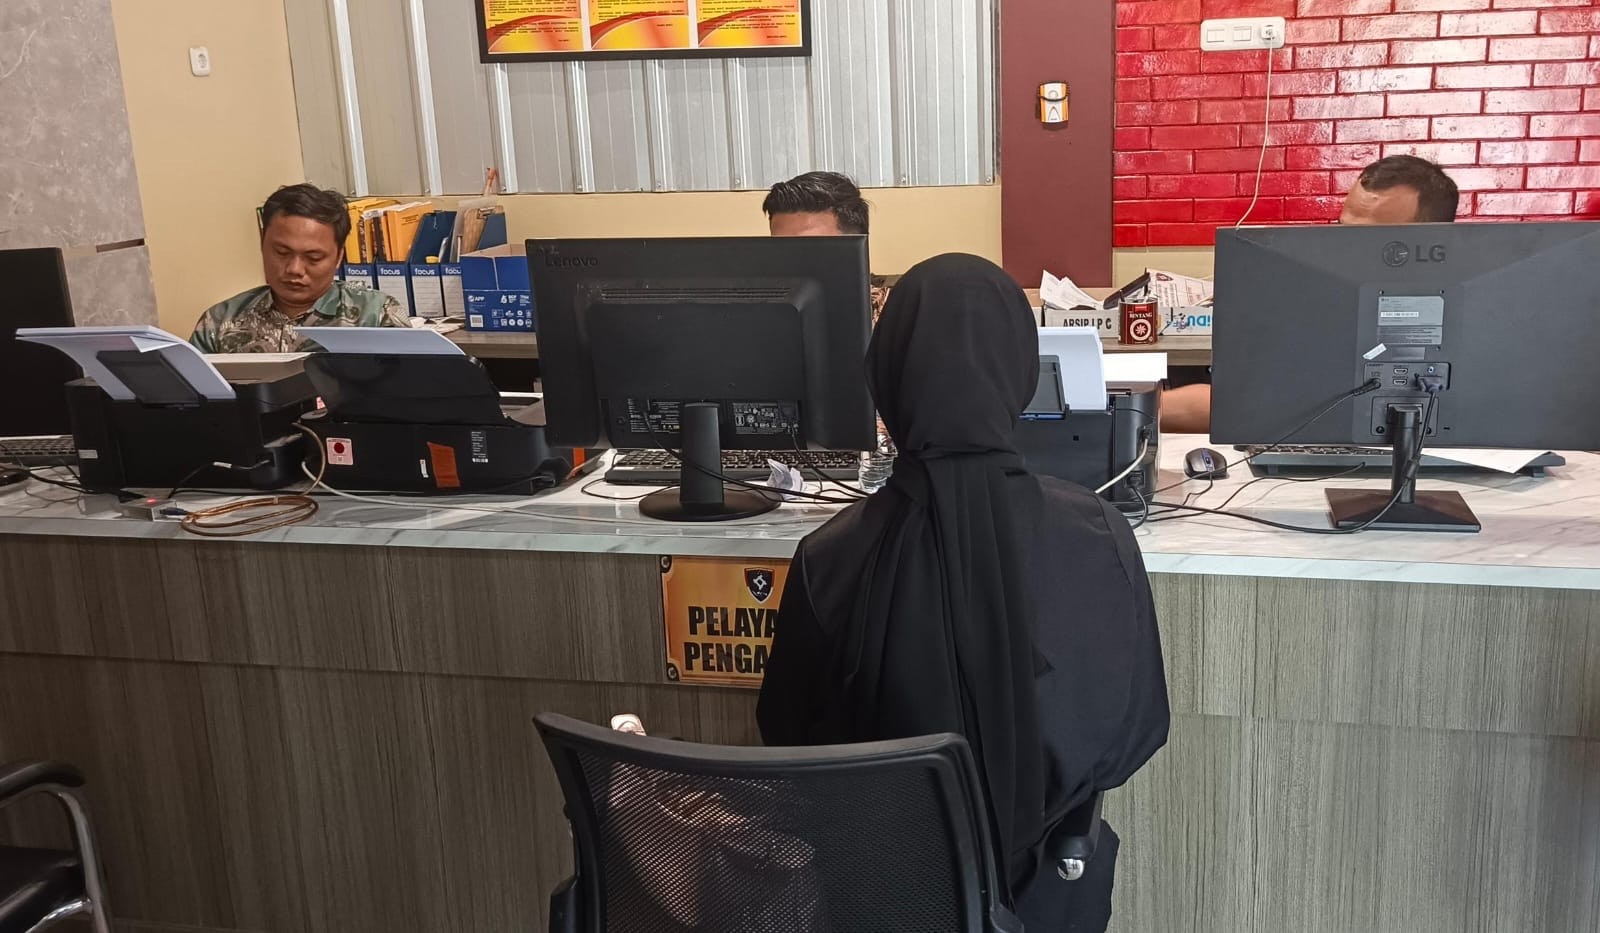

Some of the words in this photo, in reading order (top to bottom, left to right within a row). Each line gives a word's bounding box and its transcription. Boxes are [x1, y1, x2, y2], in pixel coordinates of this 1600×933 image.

[1415, 245, 1446, 262] LG
[545, 254, 599, 267] Lenovo
[347, 267, 368, 275] focus
[380, 267, 401, 275] focus
[414, 267, 435, 276] focus
[445, 267, 461, 275] focu
[688, 605, 780, 638] PELAYA
[683, 641, 771, 674] PENGA
